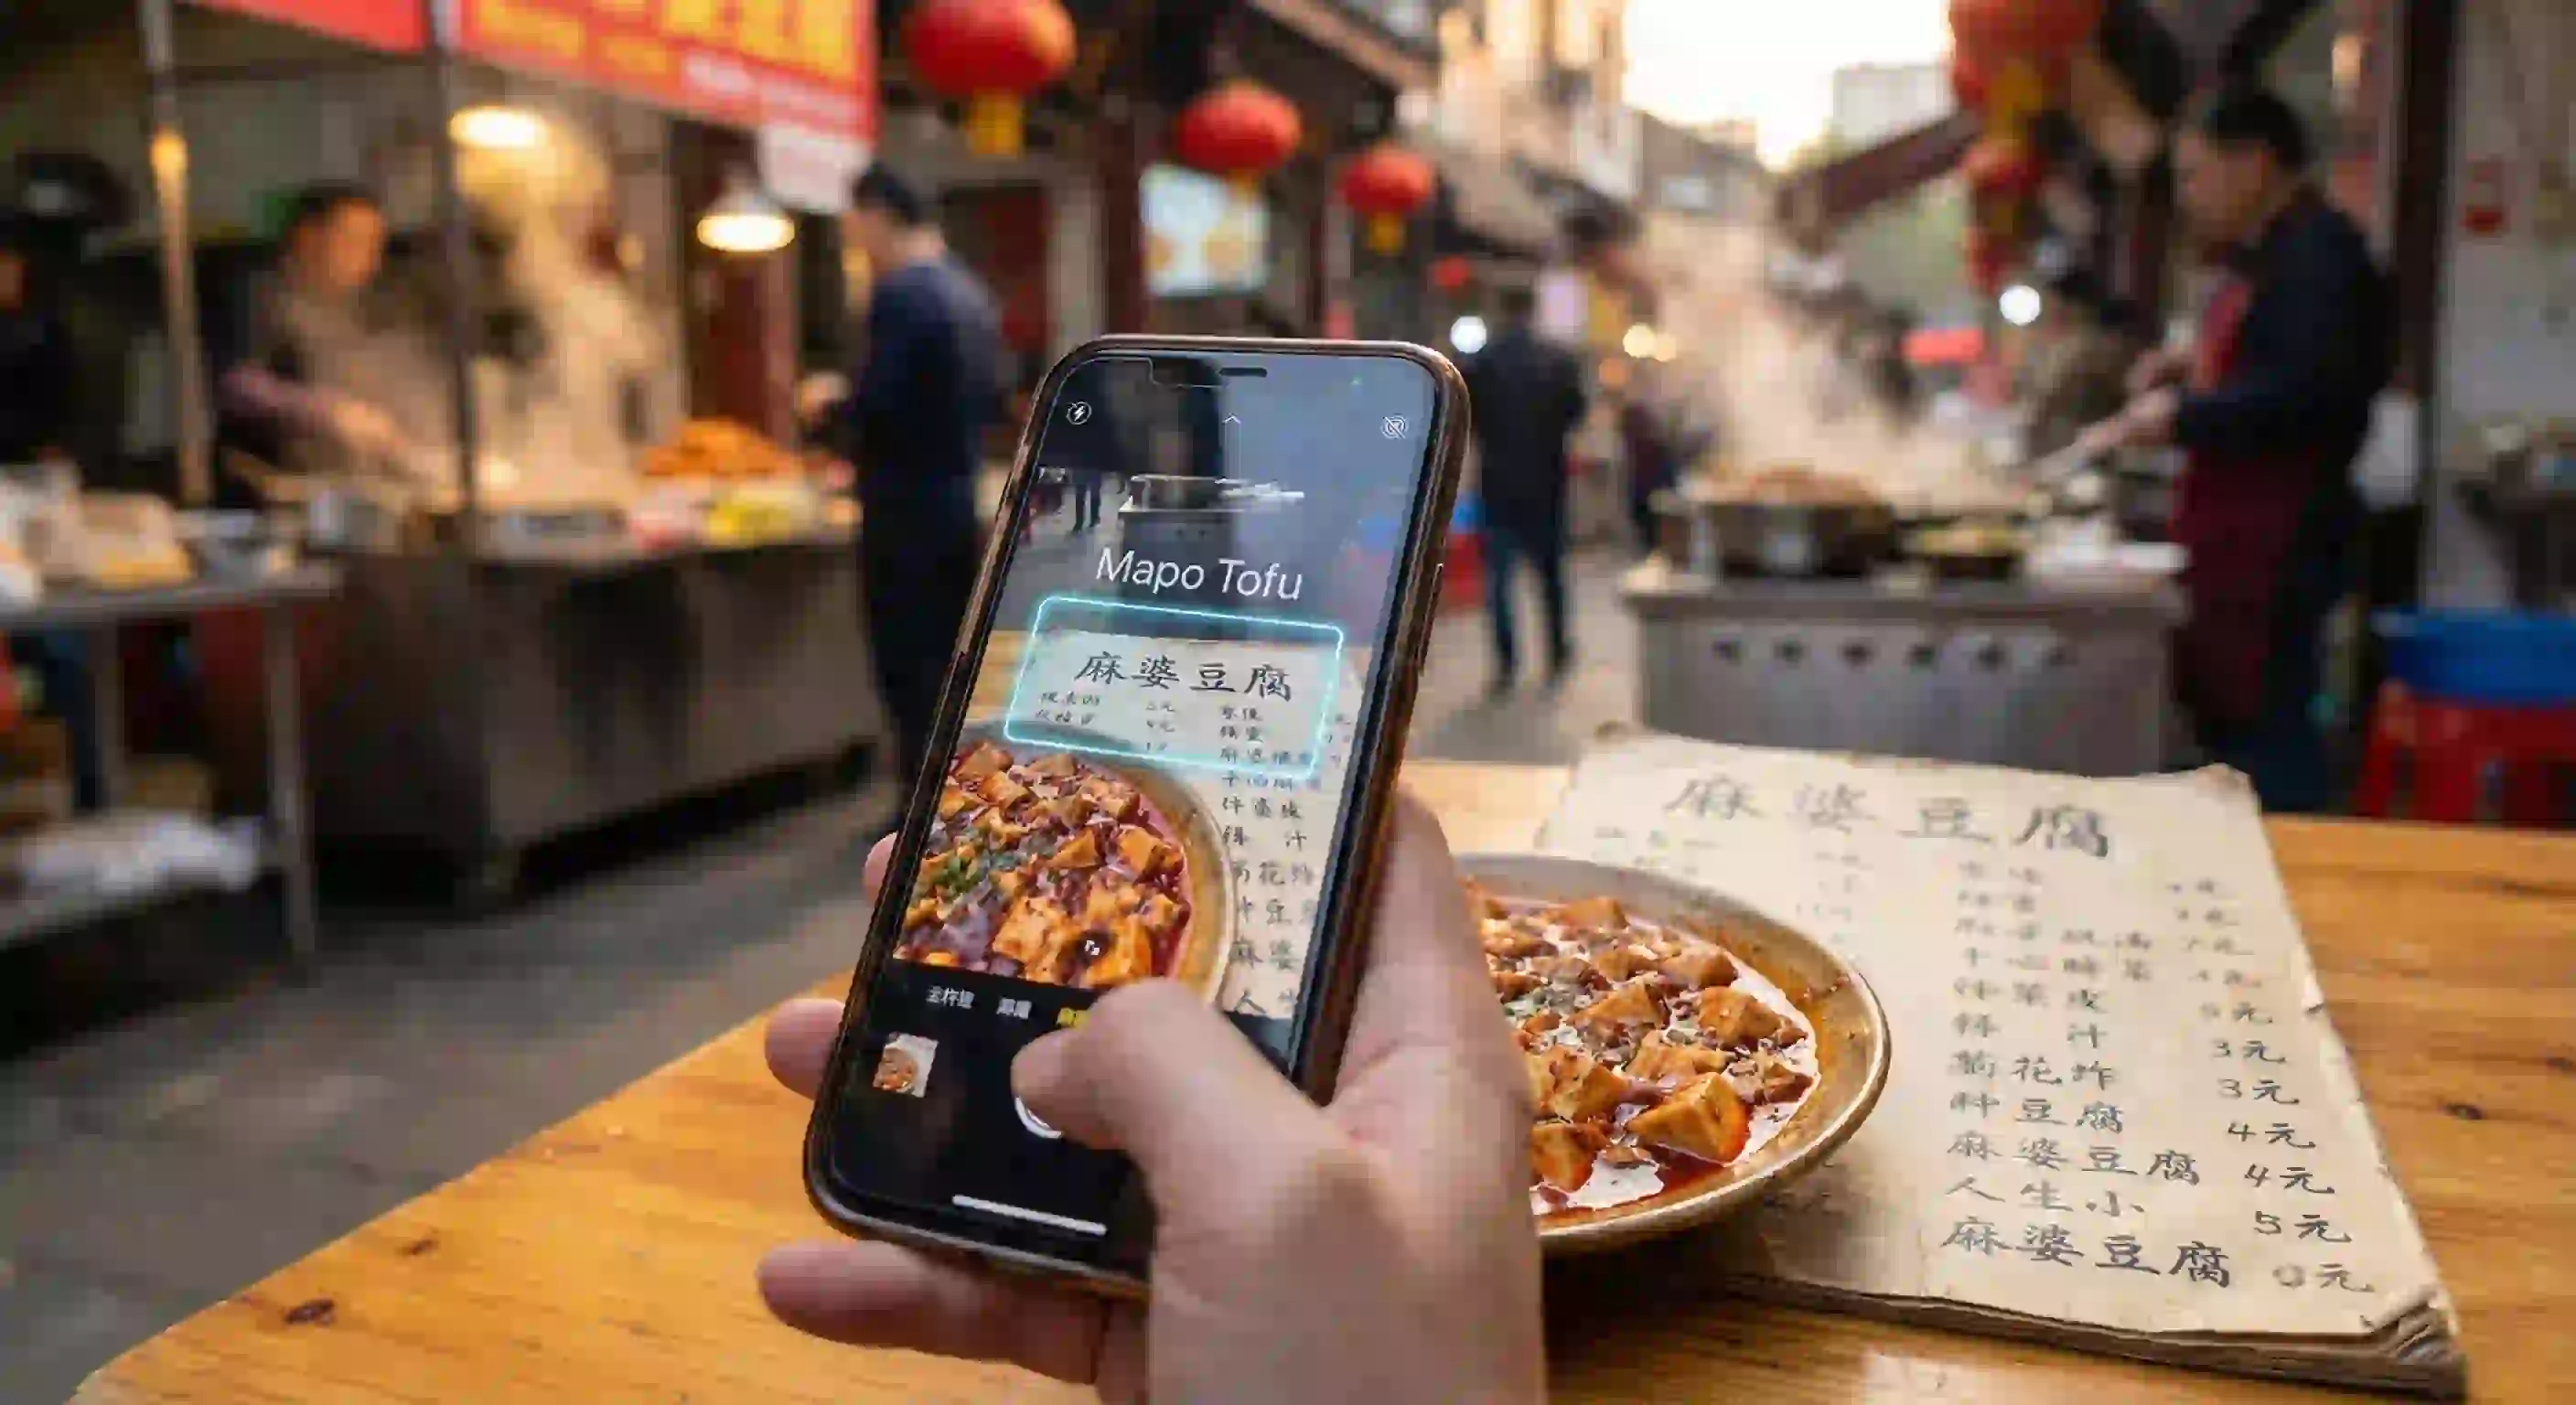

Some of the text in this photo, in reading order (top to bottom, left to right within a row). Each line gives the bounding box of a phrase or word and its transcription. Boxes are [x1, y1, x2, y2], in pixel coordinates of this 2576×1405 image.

[1096, 547, 1303, 600] Mapo Tofu
[1074, 650, 1291, 702] 麻婆豆腐
[1663, 776, 2109, 858] 麻婆豆腐
[2211, 1039, 2287, 1064] 3元
[2217, 1078, 2300, 1105] 3元
[2227, 1121, 2316, 1149] 4元
[1947, 1131, 2335, 1195] 麻婆豆腐 4元
[1945, 1175, 2353, 1243] 人生小 5元
[1940, 1216, 2229, 1289] 麻婆豆腐
